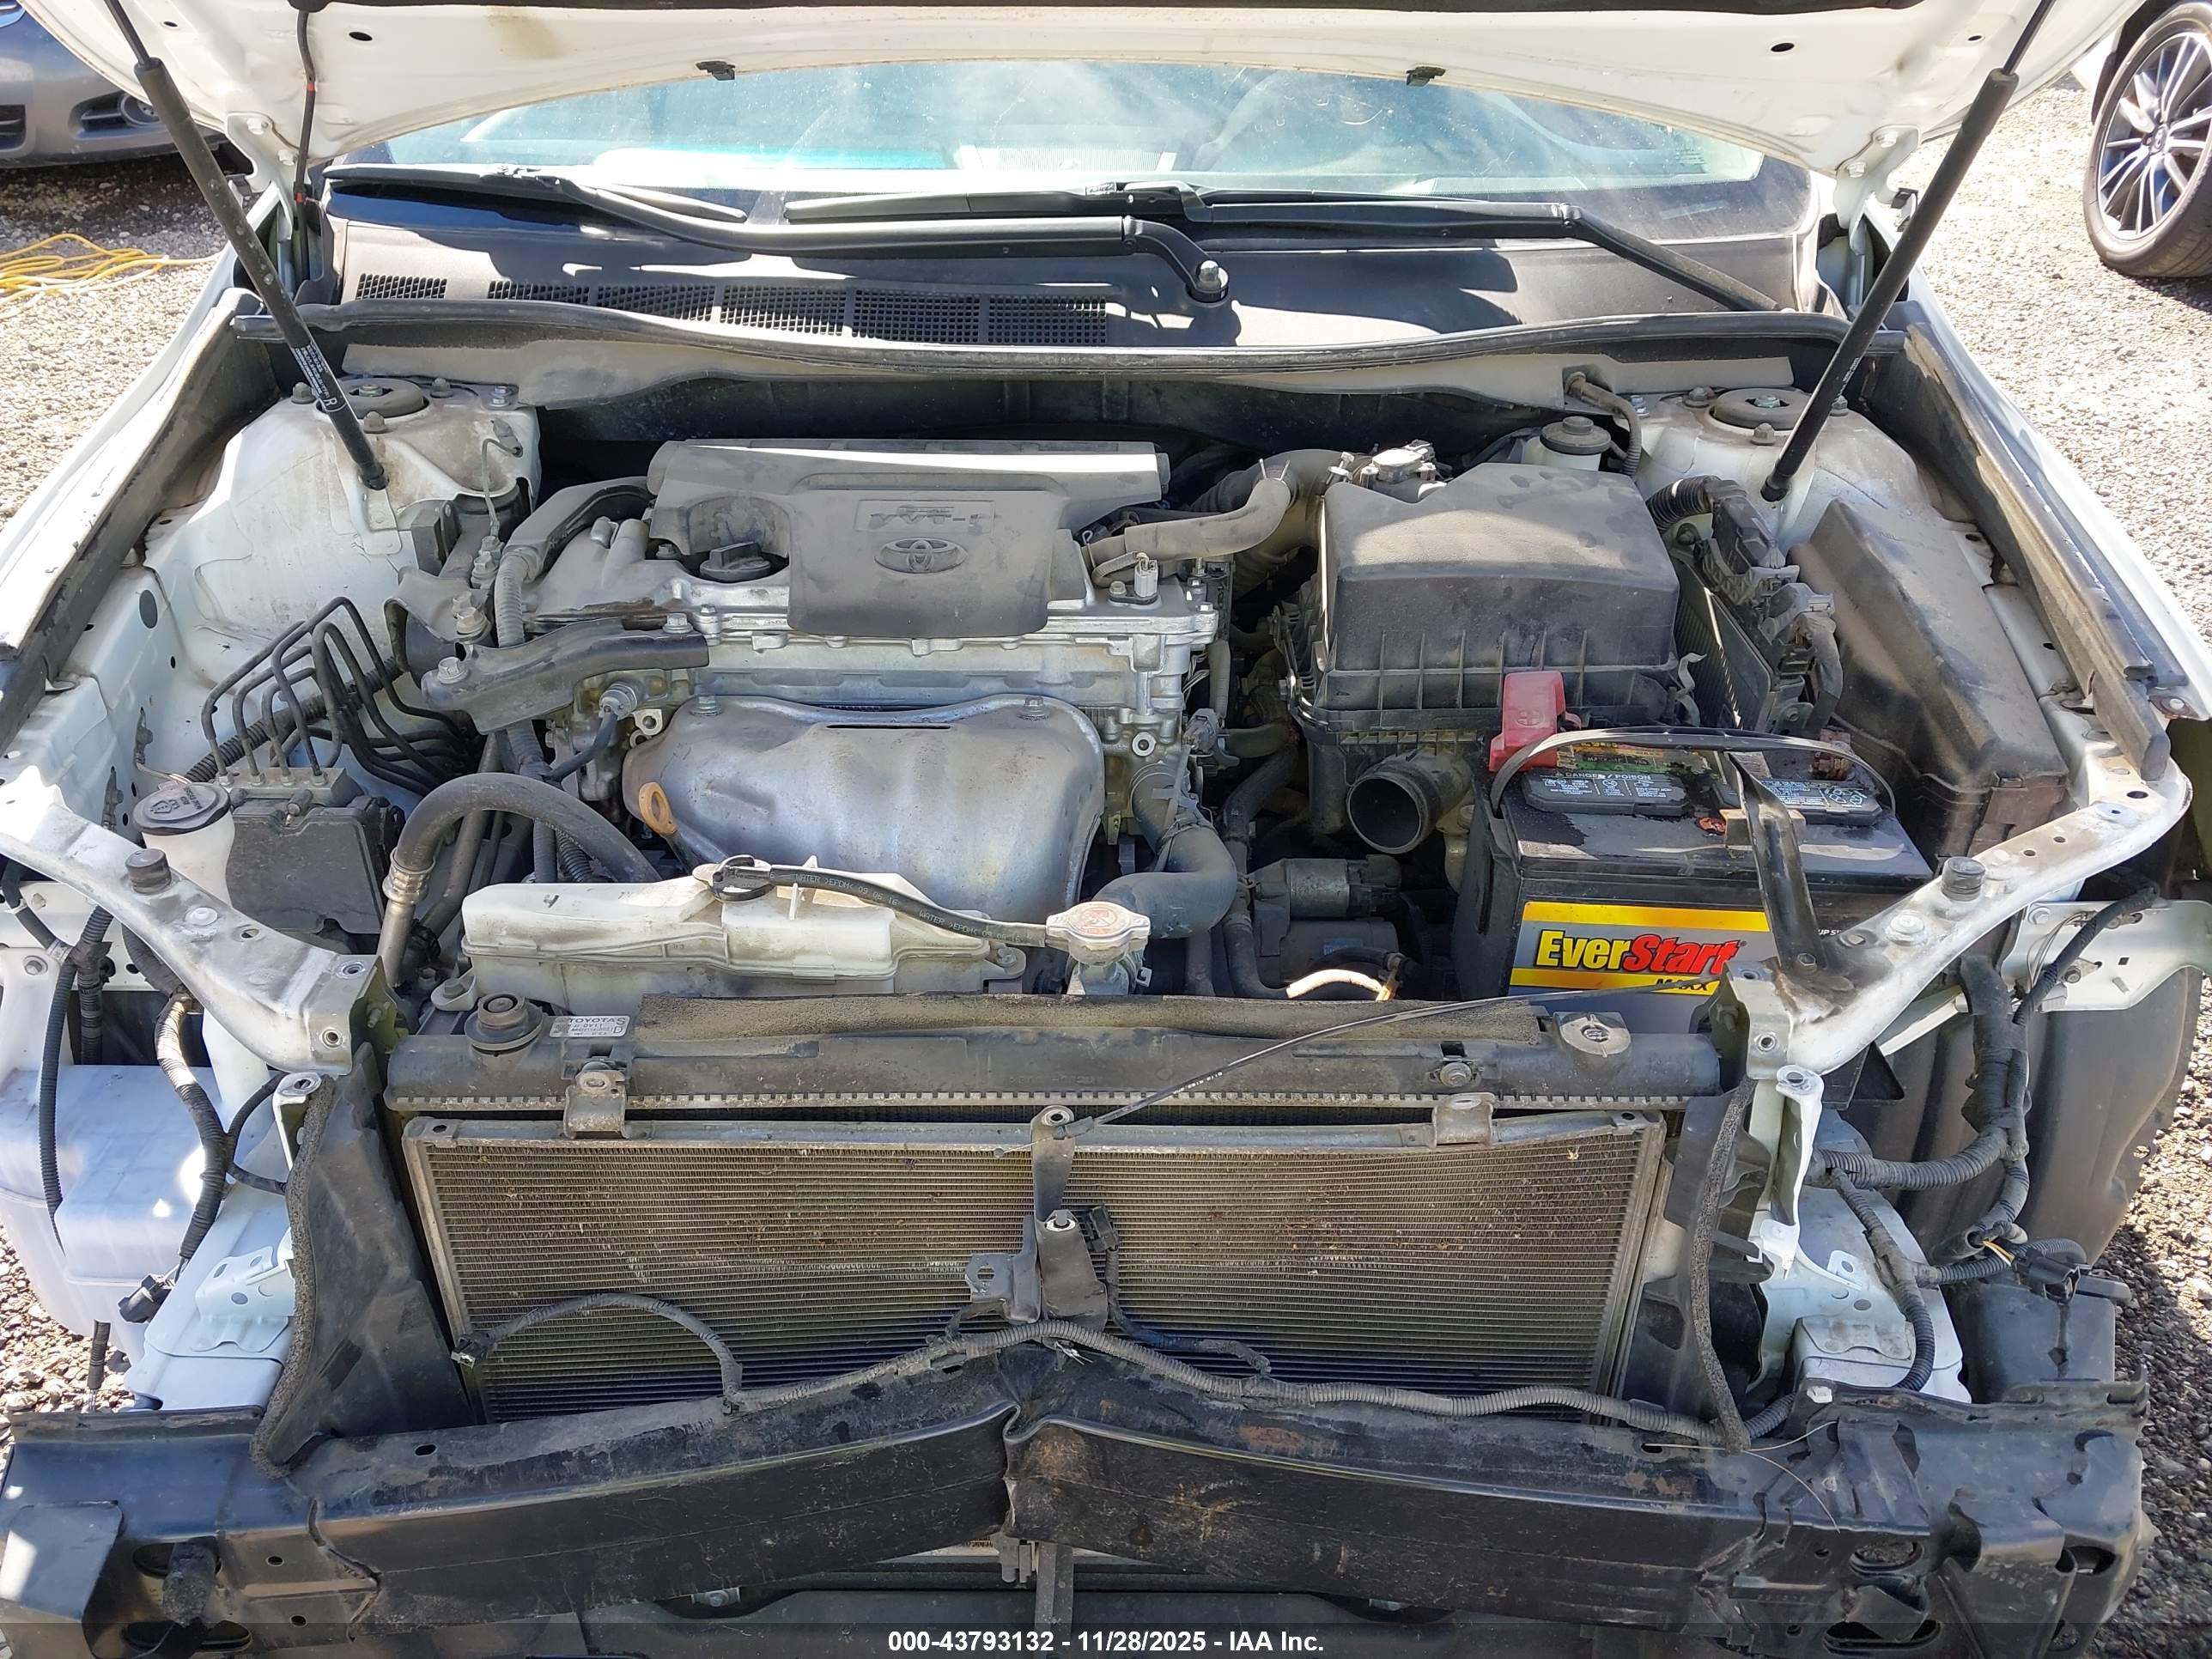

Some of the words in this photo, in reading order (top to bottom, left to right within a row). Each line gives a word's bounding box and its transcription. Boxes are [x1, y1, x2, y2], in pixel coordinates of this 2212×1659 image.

[323, 398, 337, 406] R
[796, 873, 820, 884] WATER
[919, 909, 945, 925] WATER
[1535, 929, 1741, 975] EverStart
